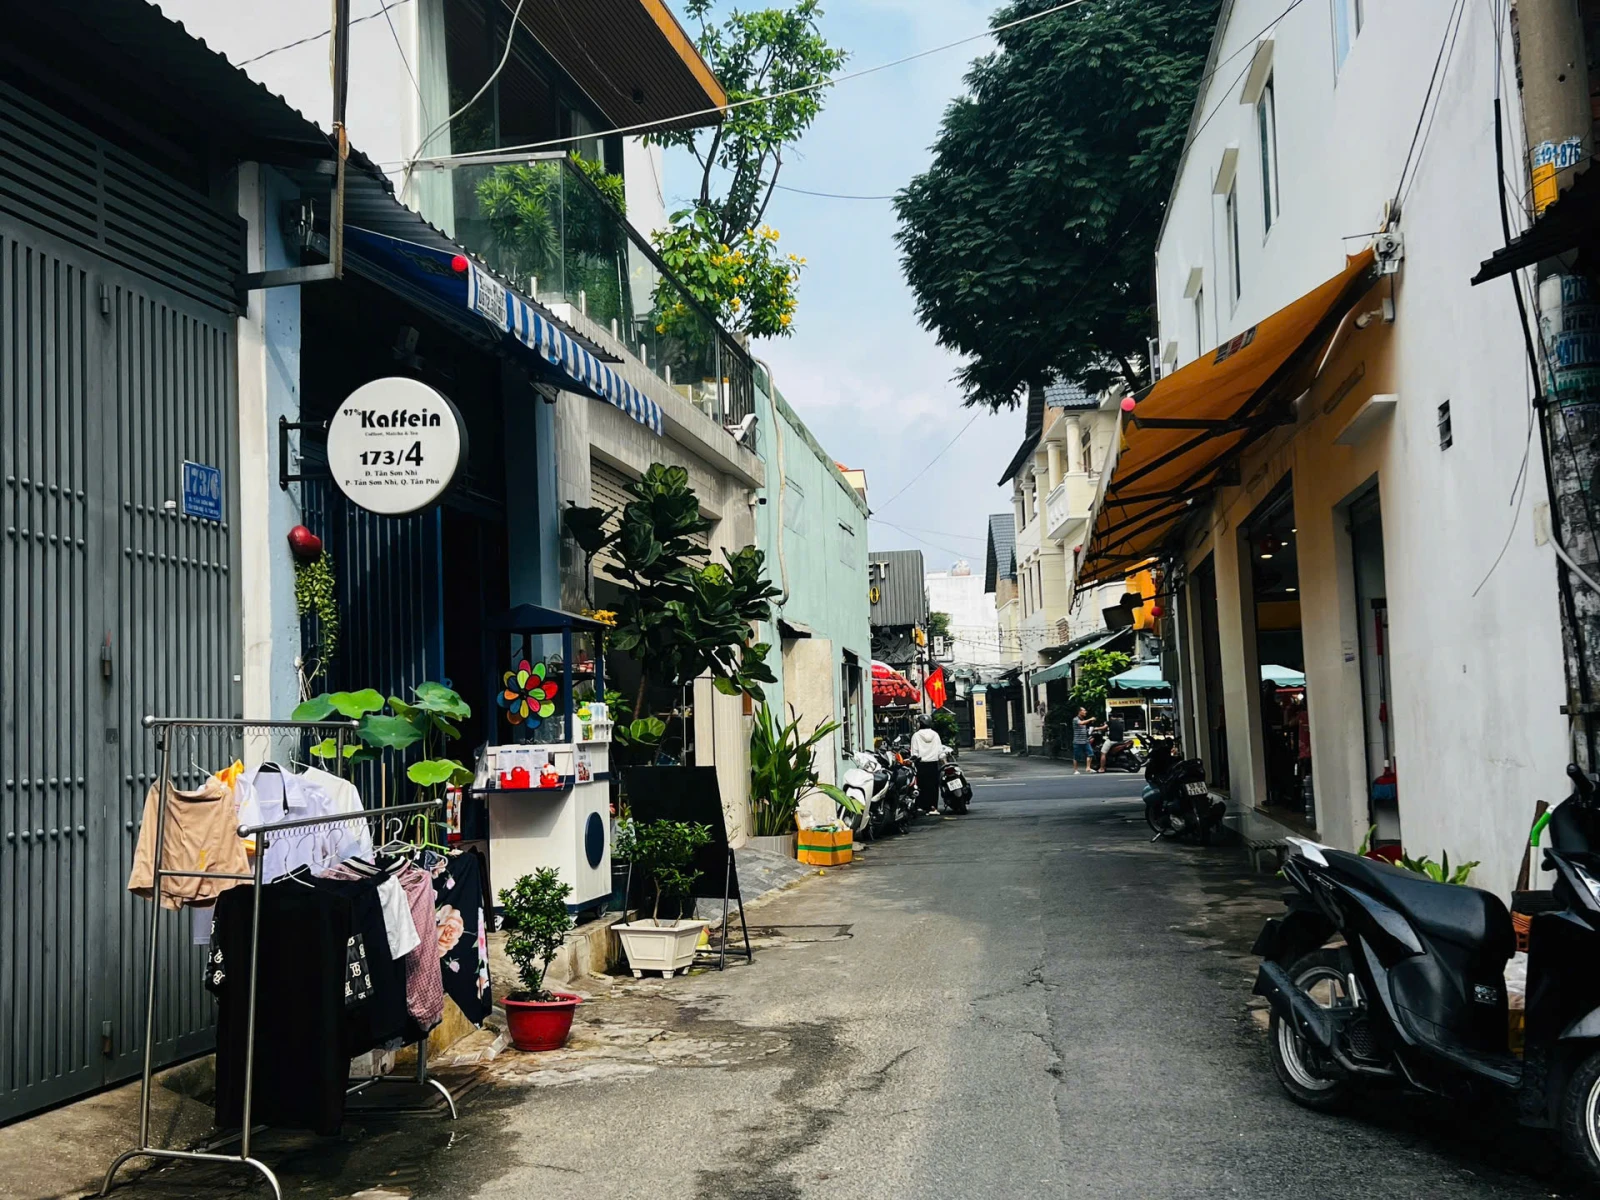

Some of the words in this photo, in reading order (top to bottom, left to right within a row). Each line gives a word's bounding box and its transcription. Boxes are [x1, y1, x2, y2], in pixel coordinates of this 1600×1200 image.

[343, 408, 361, 416] 97%
[361, 408, 441, 428] Kaffein
[359, 440, 424, 466] 173/4
